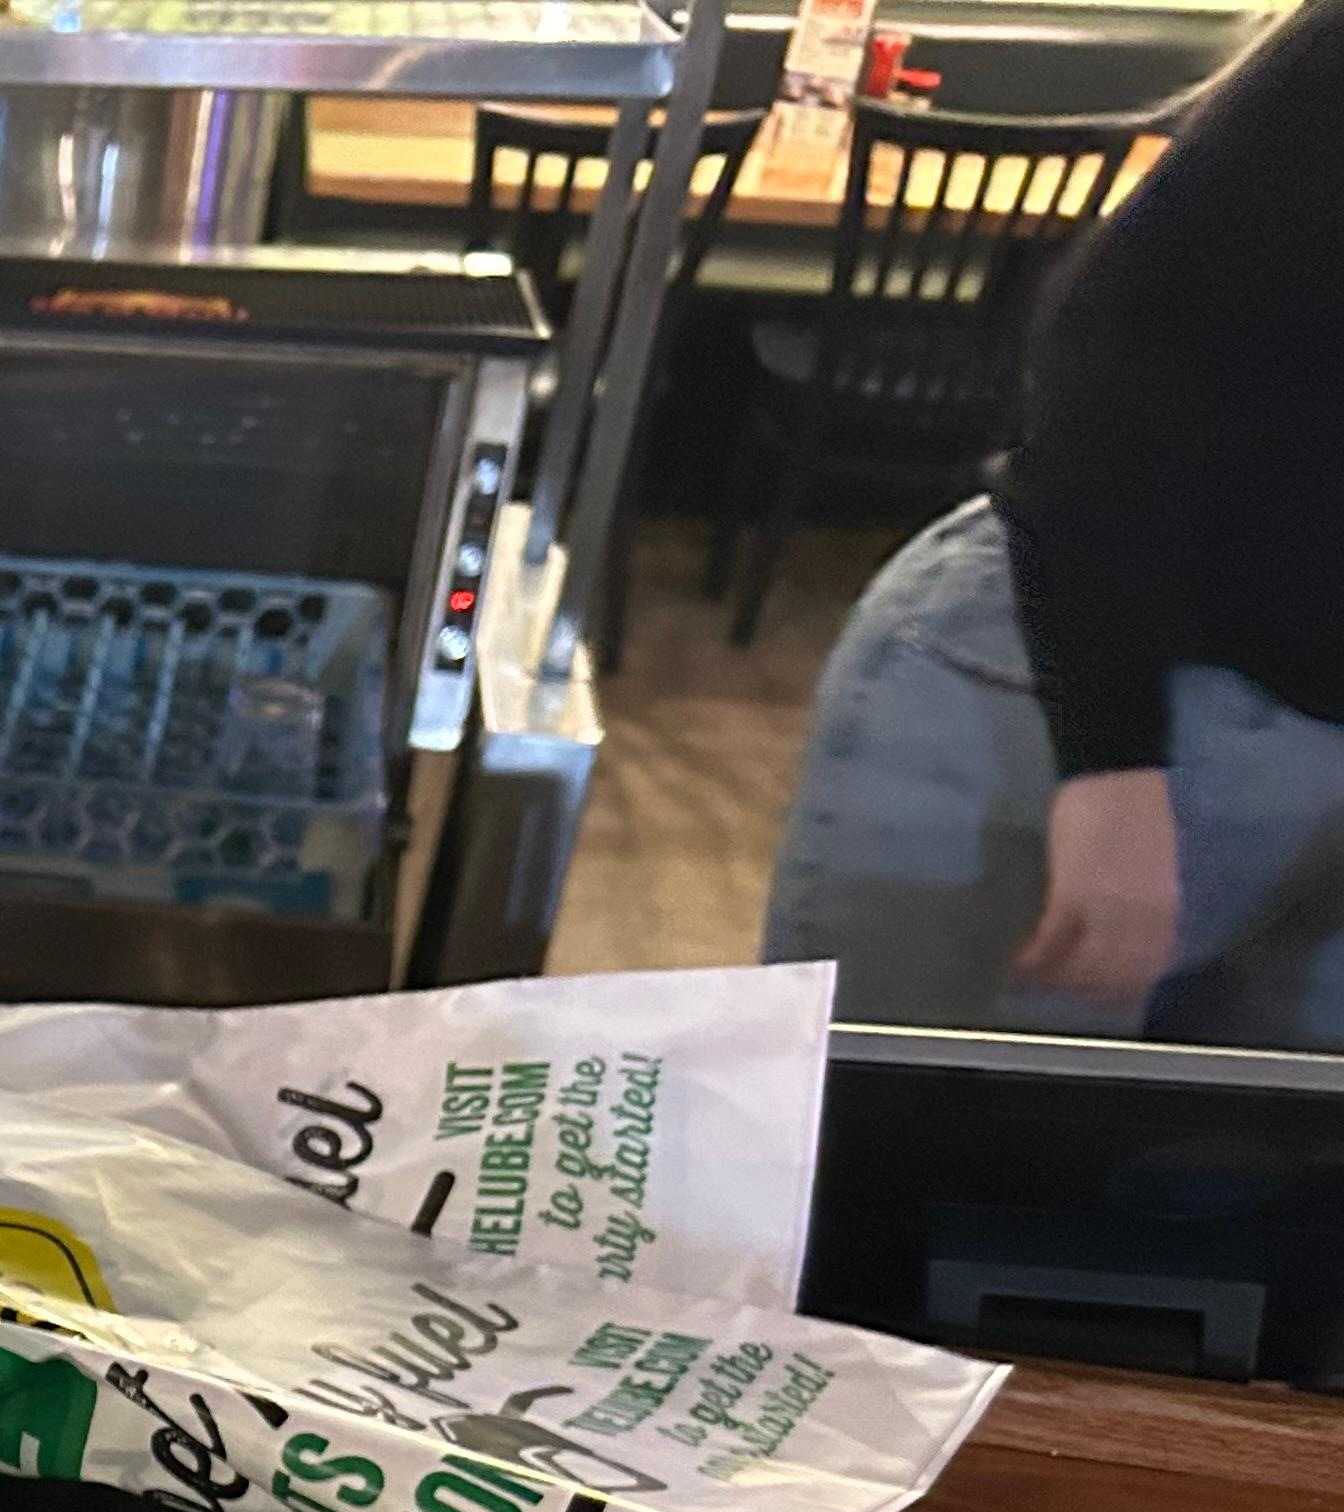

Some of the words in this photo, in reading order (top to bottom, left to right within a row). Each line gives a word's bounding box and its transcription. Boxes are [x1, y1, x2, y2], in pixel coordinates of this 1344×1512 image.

[435, 1060, 494, 1141] VISIT
[560, 1054, 606, 1107] the
[553, 1112, 611, 1181] get
[610, 1051, 663, 1211] started!
[538, 1183, 584, 1230] to
